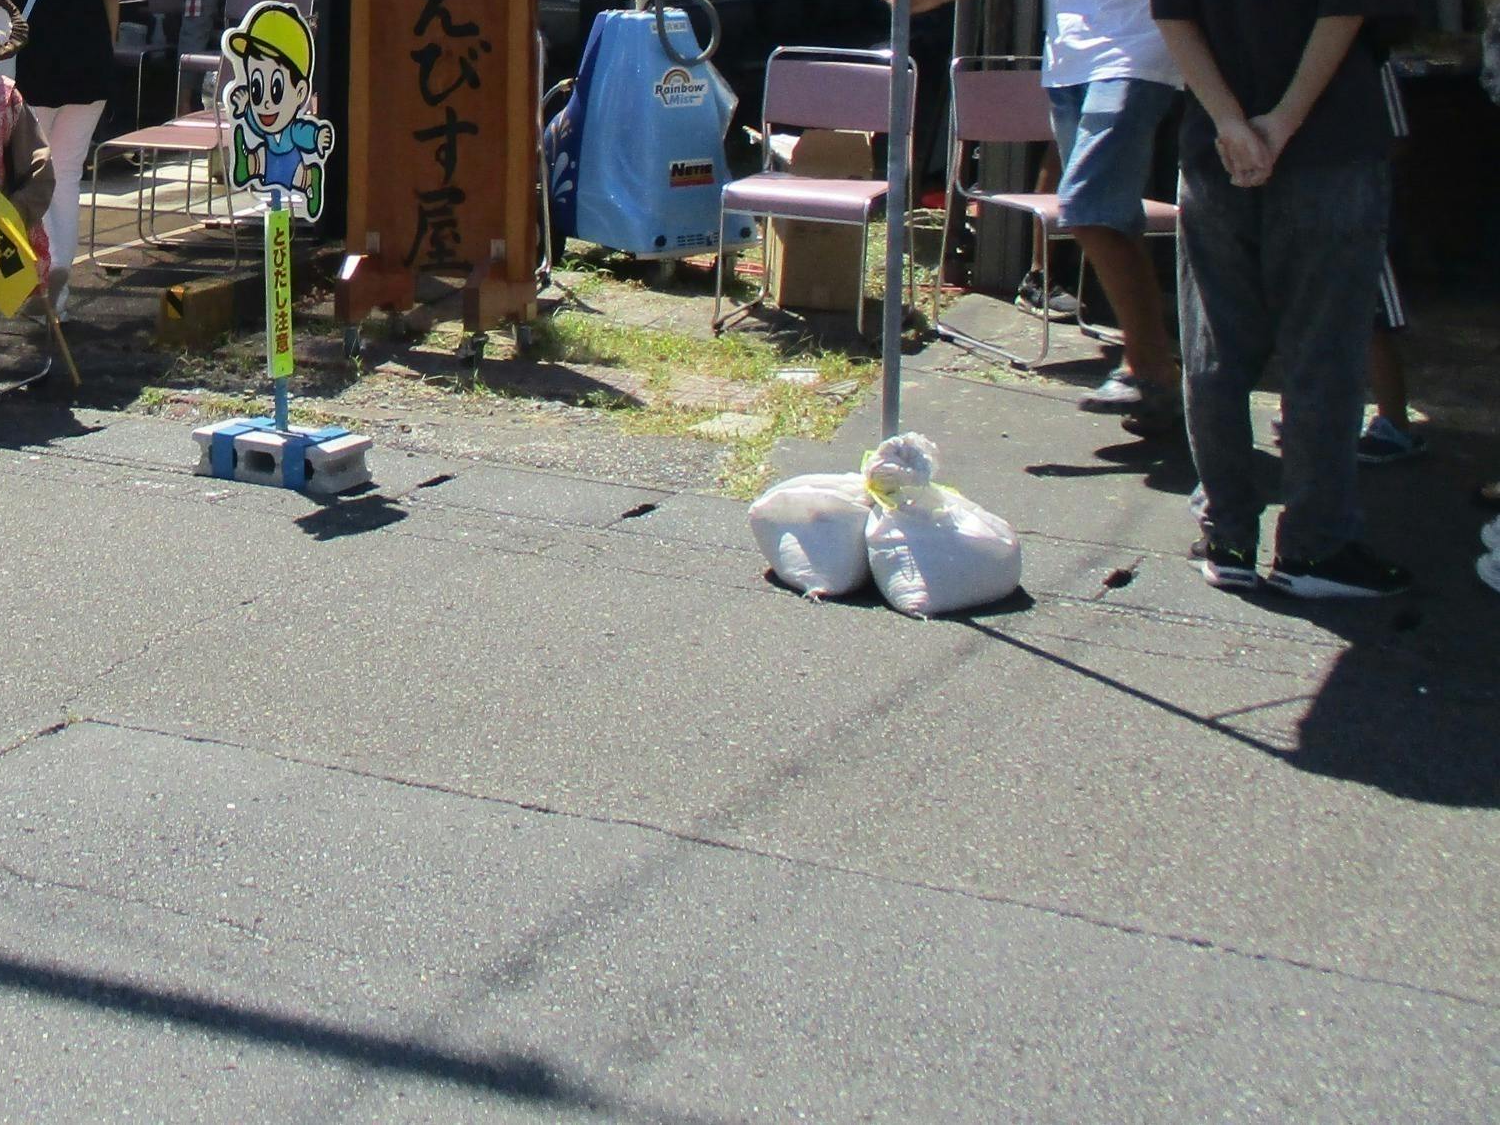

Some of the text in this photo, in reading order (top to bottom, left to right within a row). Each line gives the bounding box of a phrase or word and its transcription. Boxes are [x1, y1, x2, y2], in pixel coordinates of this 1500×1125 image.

[655, 82, 705, 97] Rainbow
[273, 228, 289, 355] とびだし注意
